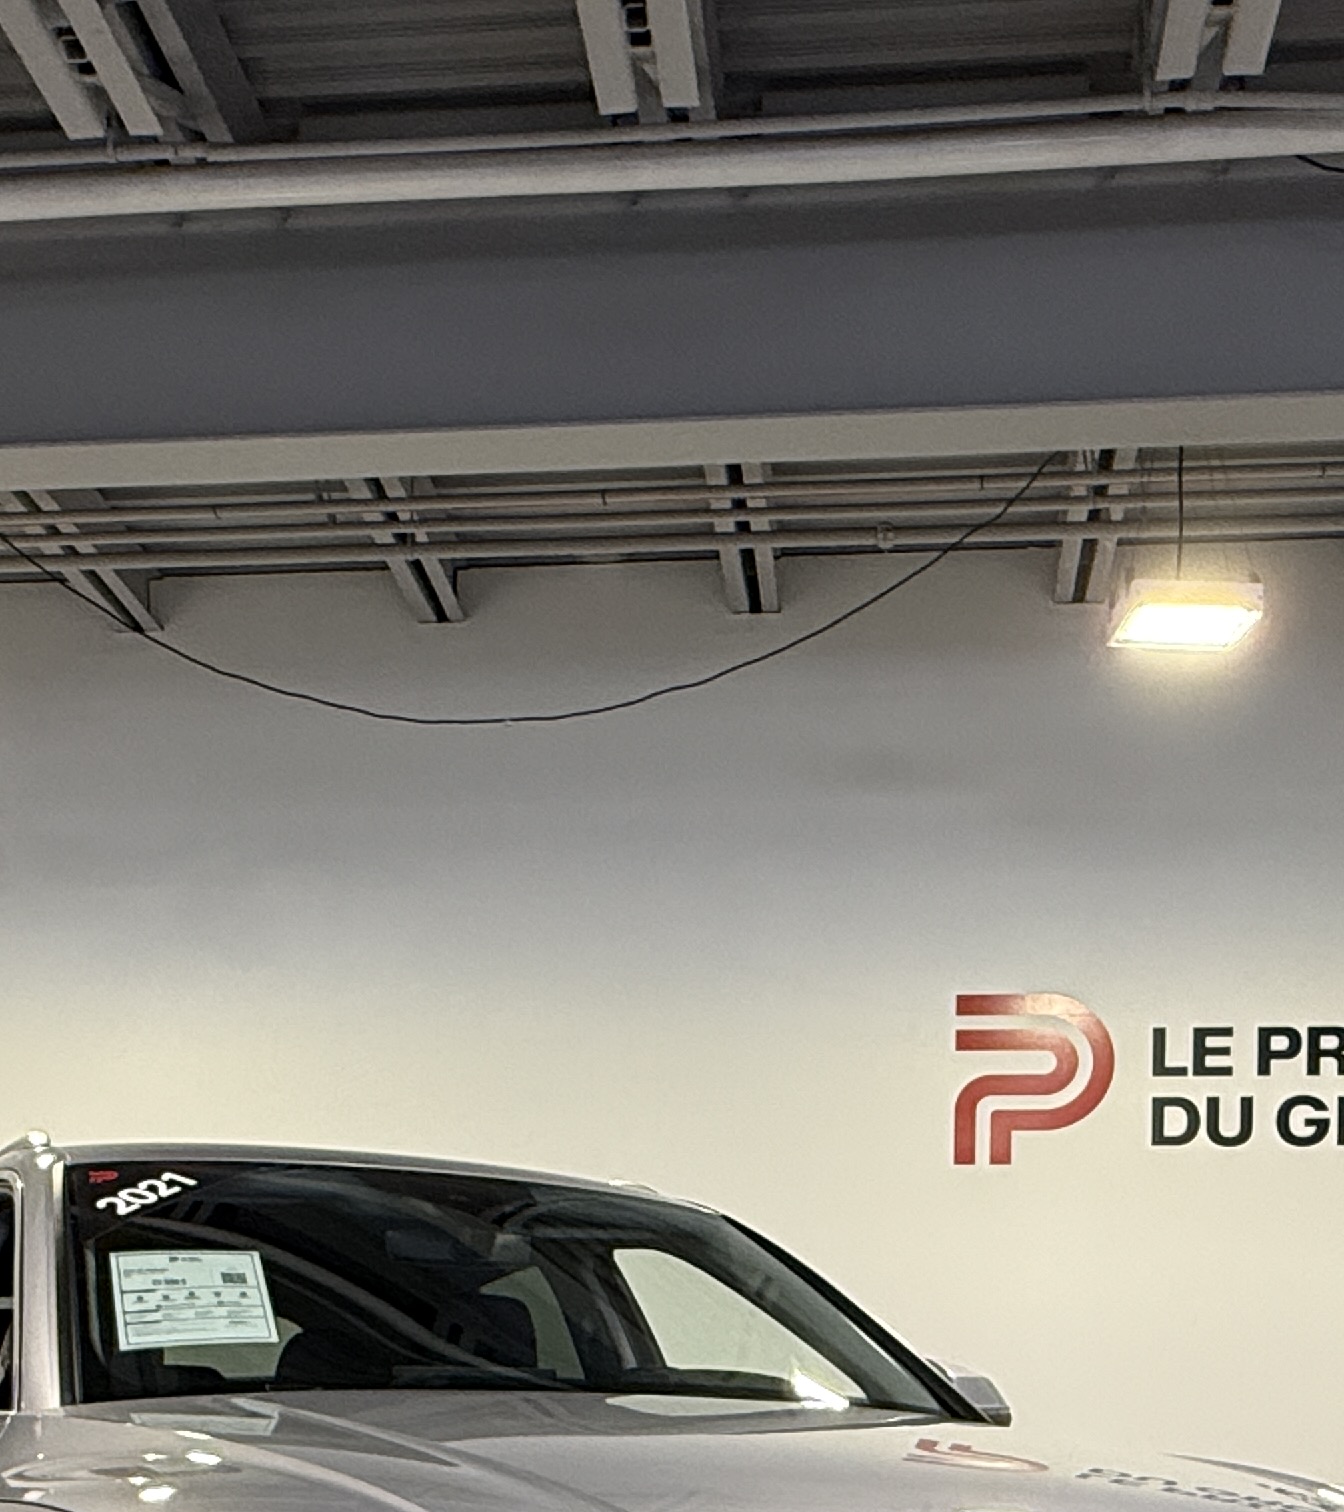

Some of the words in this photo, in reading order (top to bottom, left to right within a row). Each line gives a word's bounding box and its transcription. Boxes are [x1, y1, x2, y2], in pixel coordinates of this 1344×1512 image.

[1151, 1026, 1234, 1077] LE
[1150, 1095, 1254, 1148] DU
[95, 1172, 198, 1216] 2021
